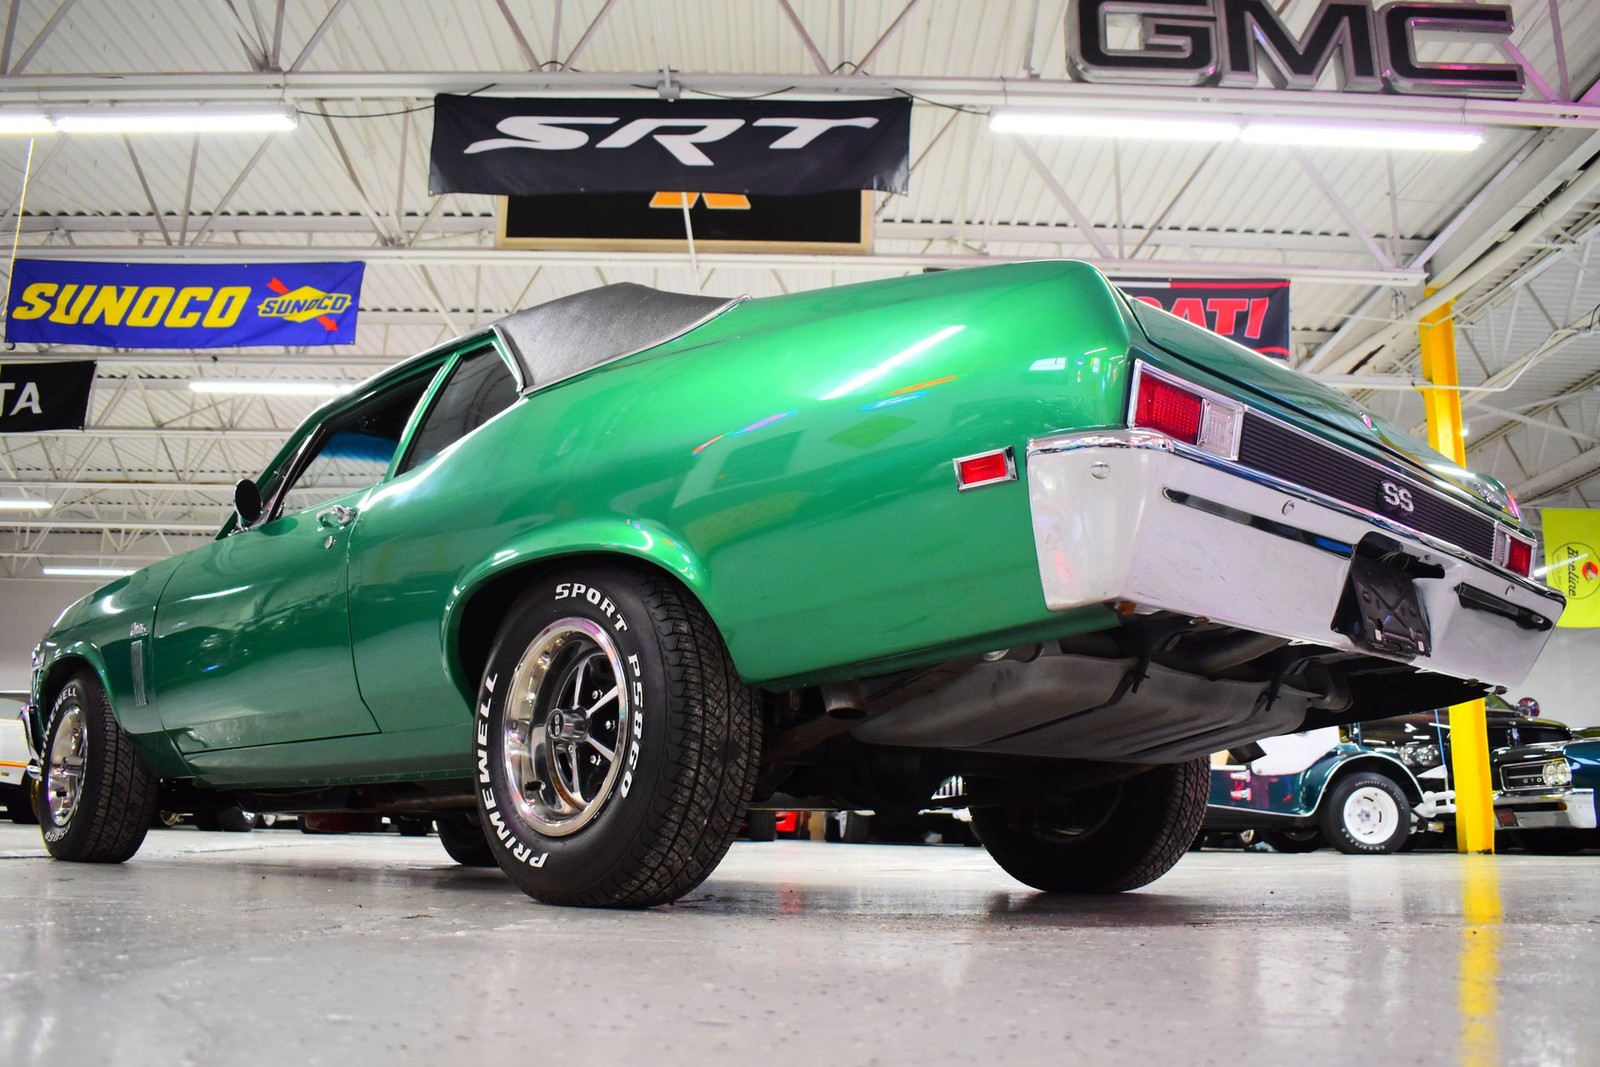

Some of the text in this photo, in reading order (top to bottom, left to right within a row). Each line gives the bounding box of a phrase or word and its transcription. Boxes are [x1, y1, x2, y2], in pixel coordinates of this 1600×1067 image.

[1066, 0, 1527, 99] GMC
[463, 116, 880, 166] SRT
[12, 282, 252, 328] SUNOCO
[261, 295, 349, 315] SUNOCO
[1134, 296, 1269, 340] ATI
[1382, 481, 1415, 512] SS
[554, 582, 629, 633] SPORT
[621, 652, 645, 799] PS860
[477, 672, 550, 869] PRIMEWELL
